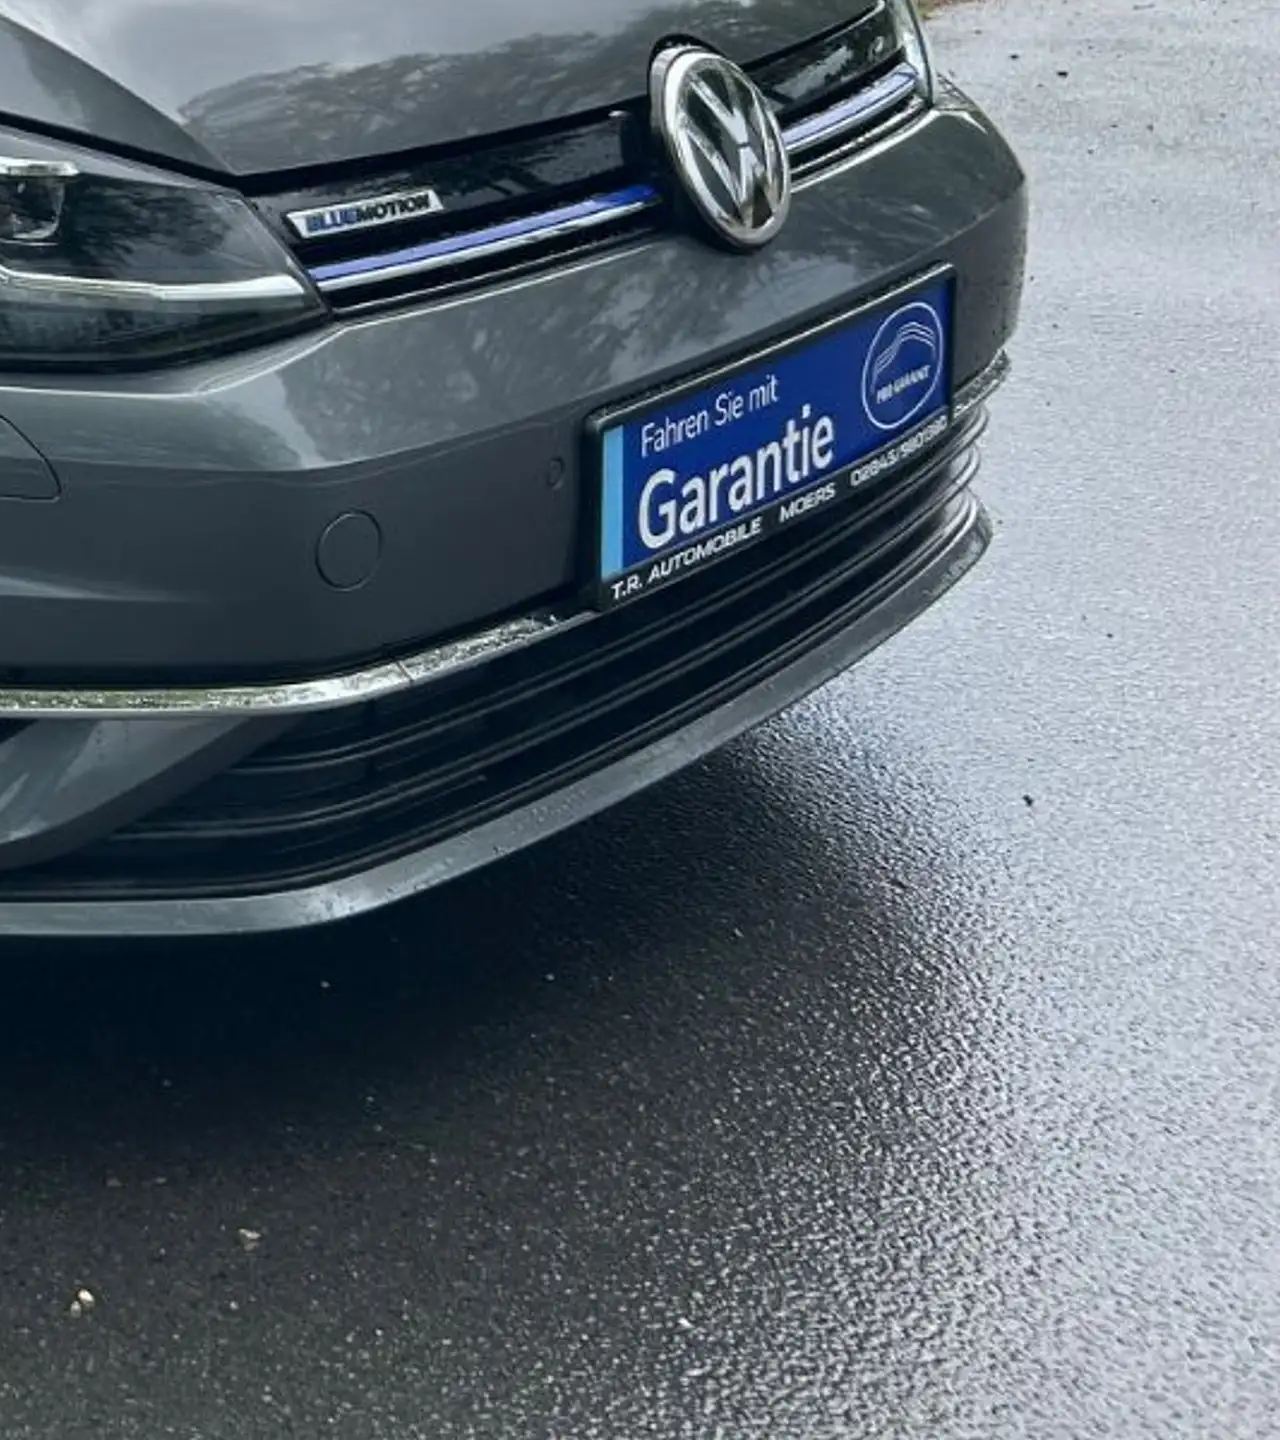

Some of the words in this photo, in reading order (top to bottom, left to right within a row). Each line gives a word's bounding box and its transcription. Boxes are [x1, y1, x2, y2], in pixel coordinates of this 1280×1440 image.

[641, 408, 709, 459] Fahren
[714, 391, 743, 429] Sie
[749, 374, 779, 415] mit
[638, 403, 835, 550] Garantie
[611, 578, 643, 600] T.R.
[648, 516, 762, 585] AUTOMOBILE
[779, 482, 837, 524] MOERS
